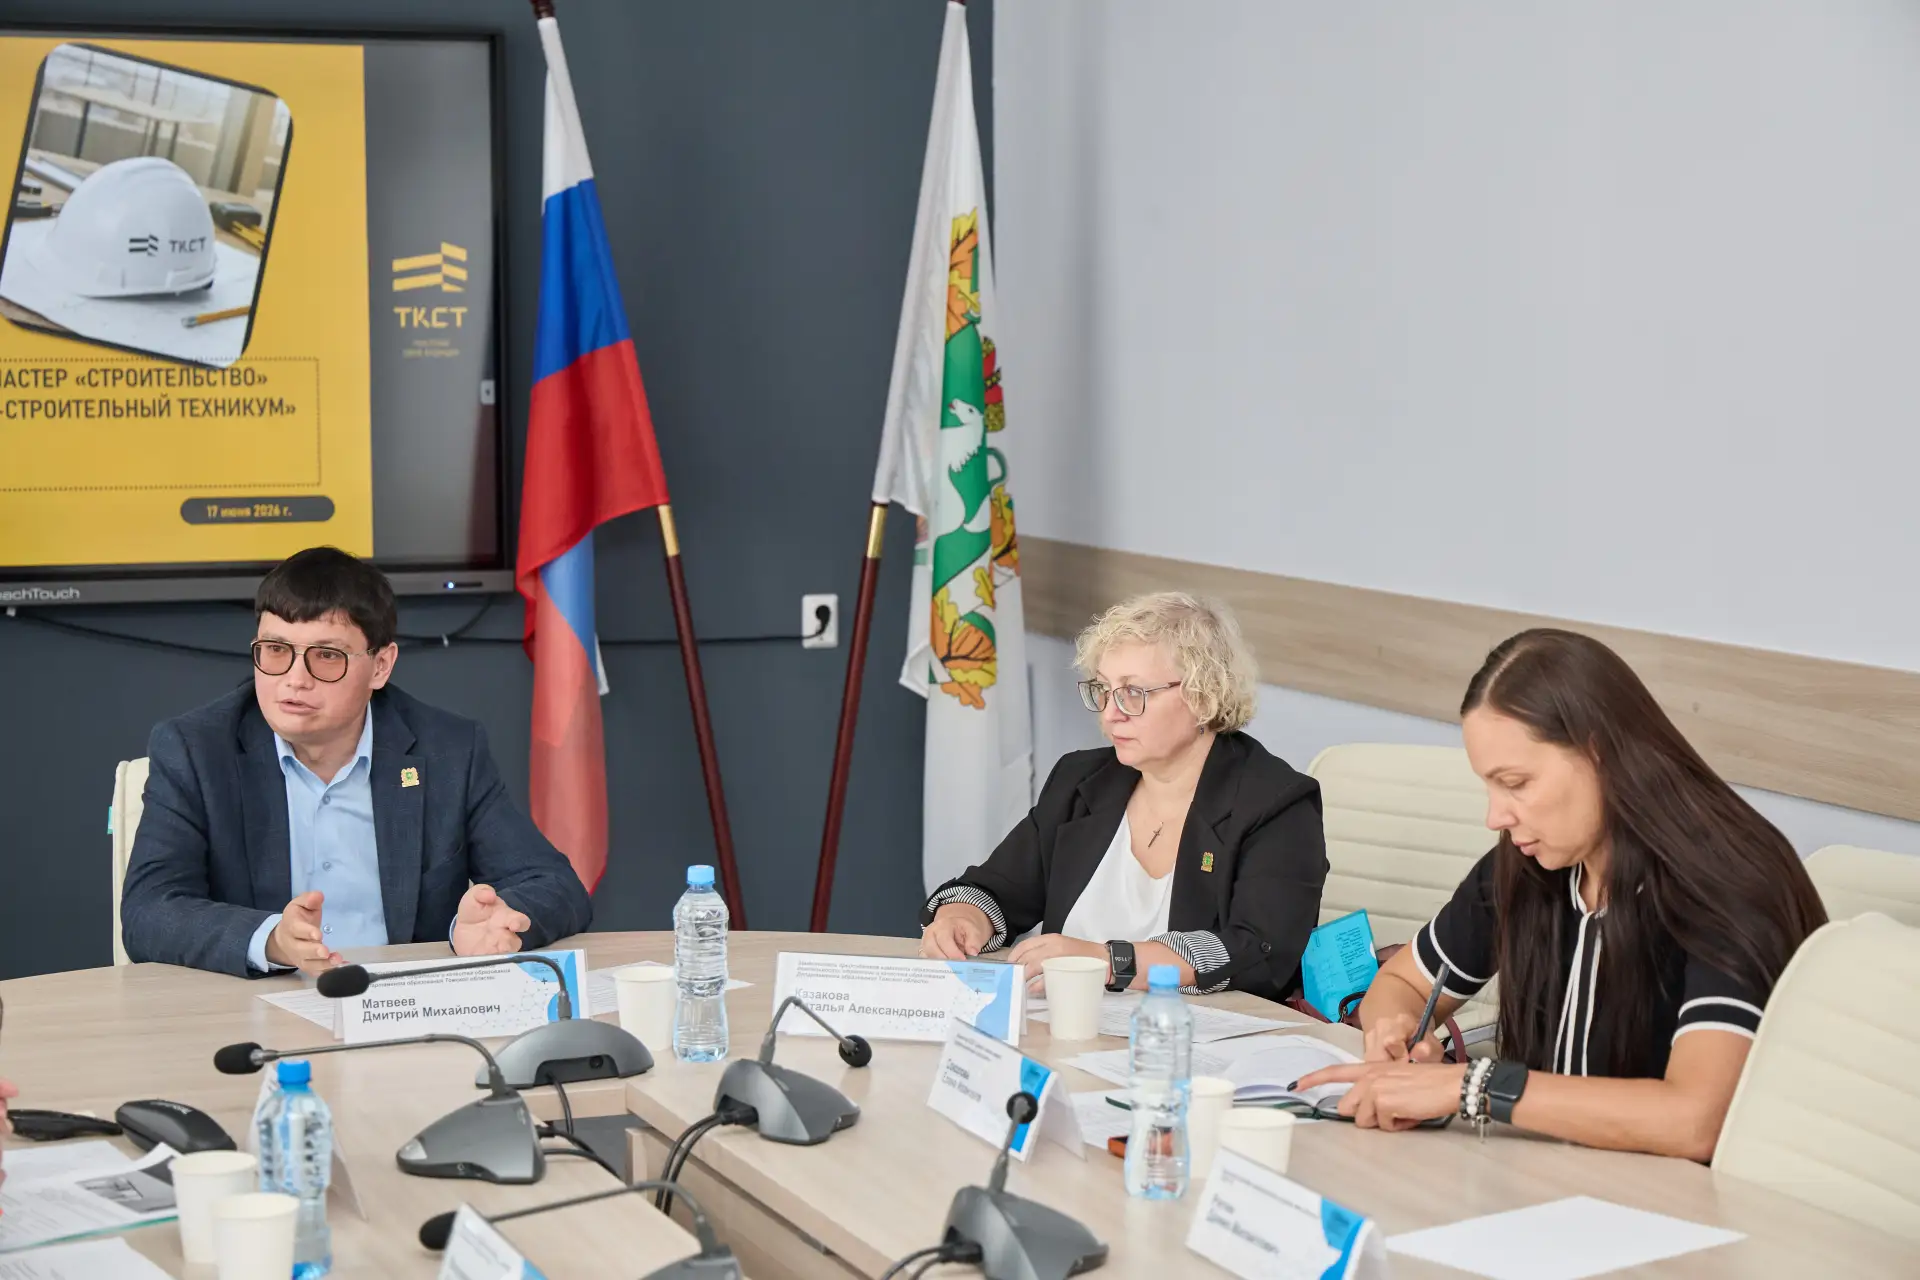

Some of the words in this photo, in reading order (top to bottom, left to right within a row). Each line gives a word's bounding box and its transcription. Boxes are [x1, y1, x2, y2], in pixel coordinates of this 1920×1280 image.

[168, 236, 207, 253] ТКСТ
[393, 305, 468, 328] ТКСТ
[0, 367, 68, 388] АСТЕР
[75, 366, 268, 388] «СТРОИТЕЛЬСТВО»
[177, 397, 296, 418] ТЕХНИКУМ»
[207, 505, 218, 518] 17
[794, 986, 850, 1001] Казакова
[362, 998, 416, 1009] Матвеев
[848, 1002, 946, 1019] Александровна
[362, 1008, 419, 1024] Дмитрий
[422, 1004, 501, 1018] Михайлович
